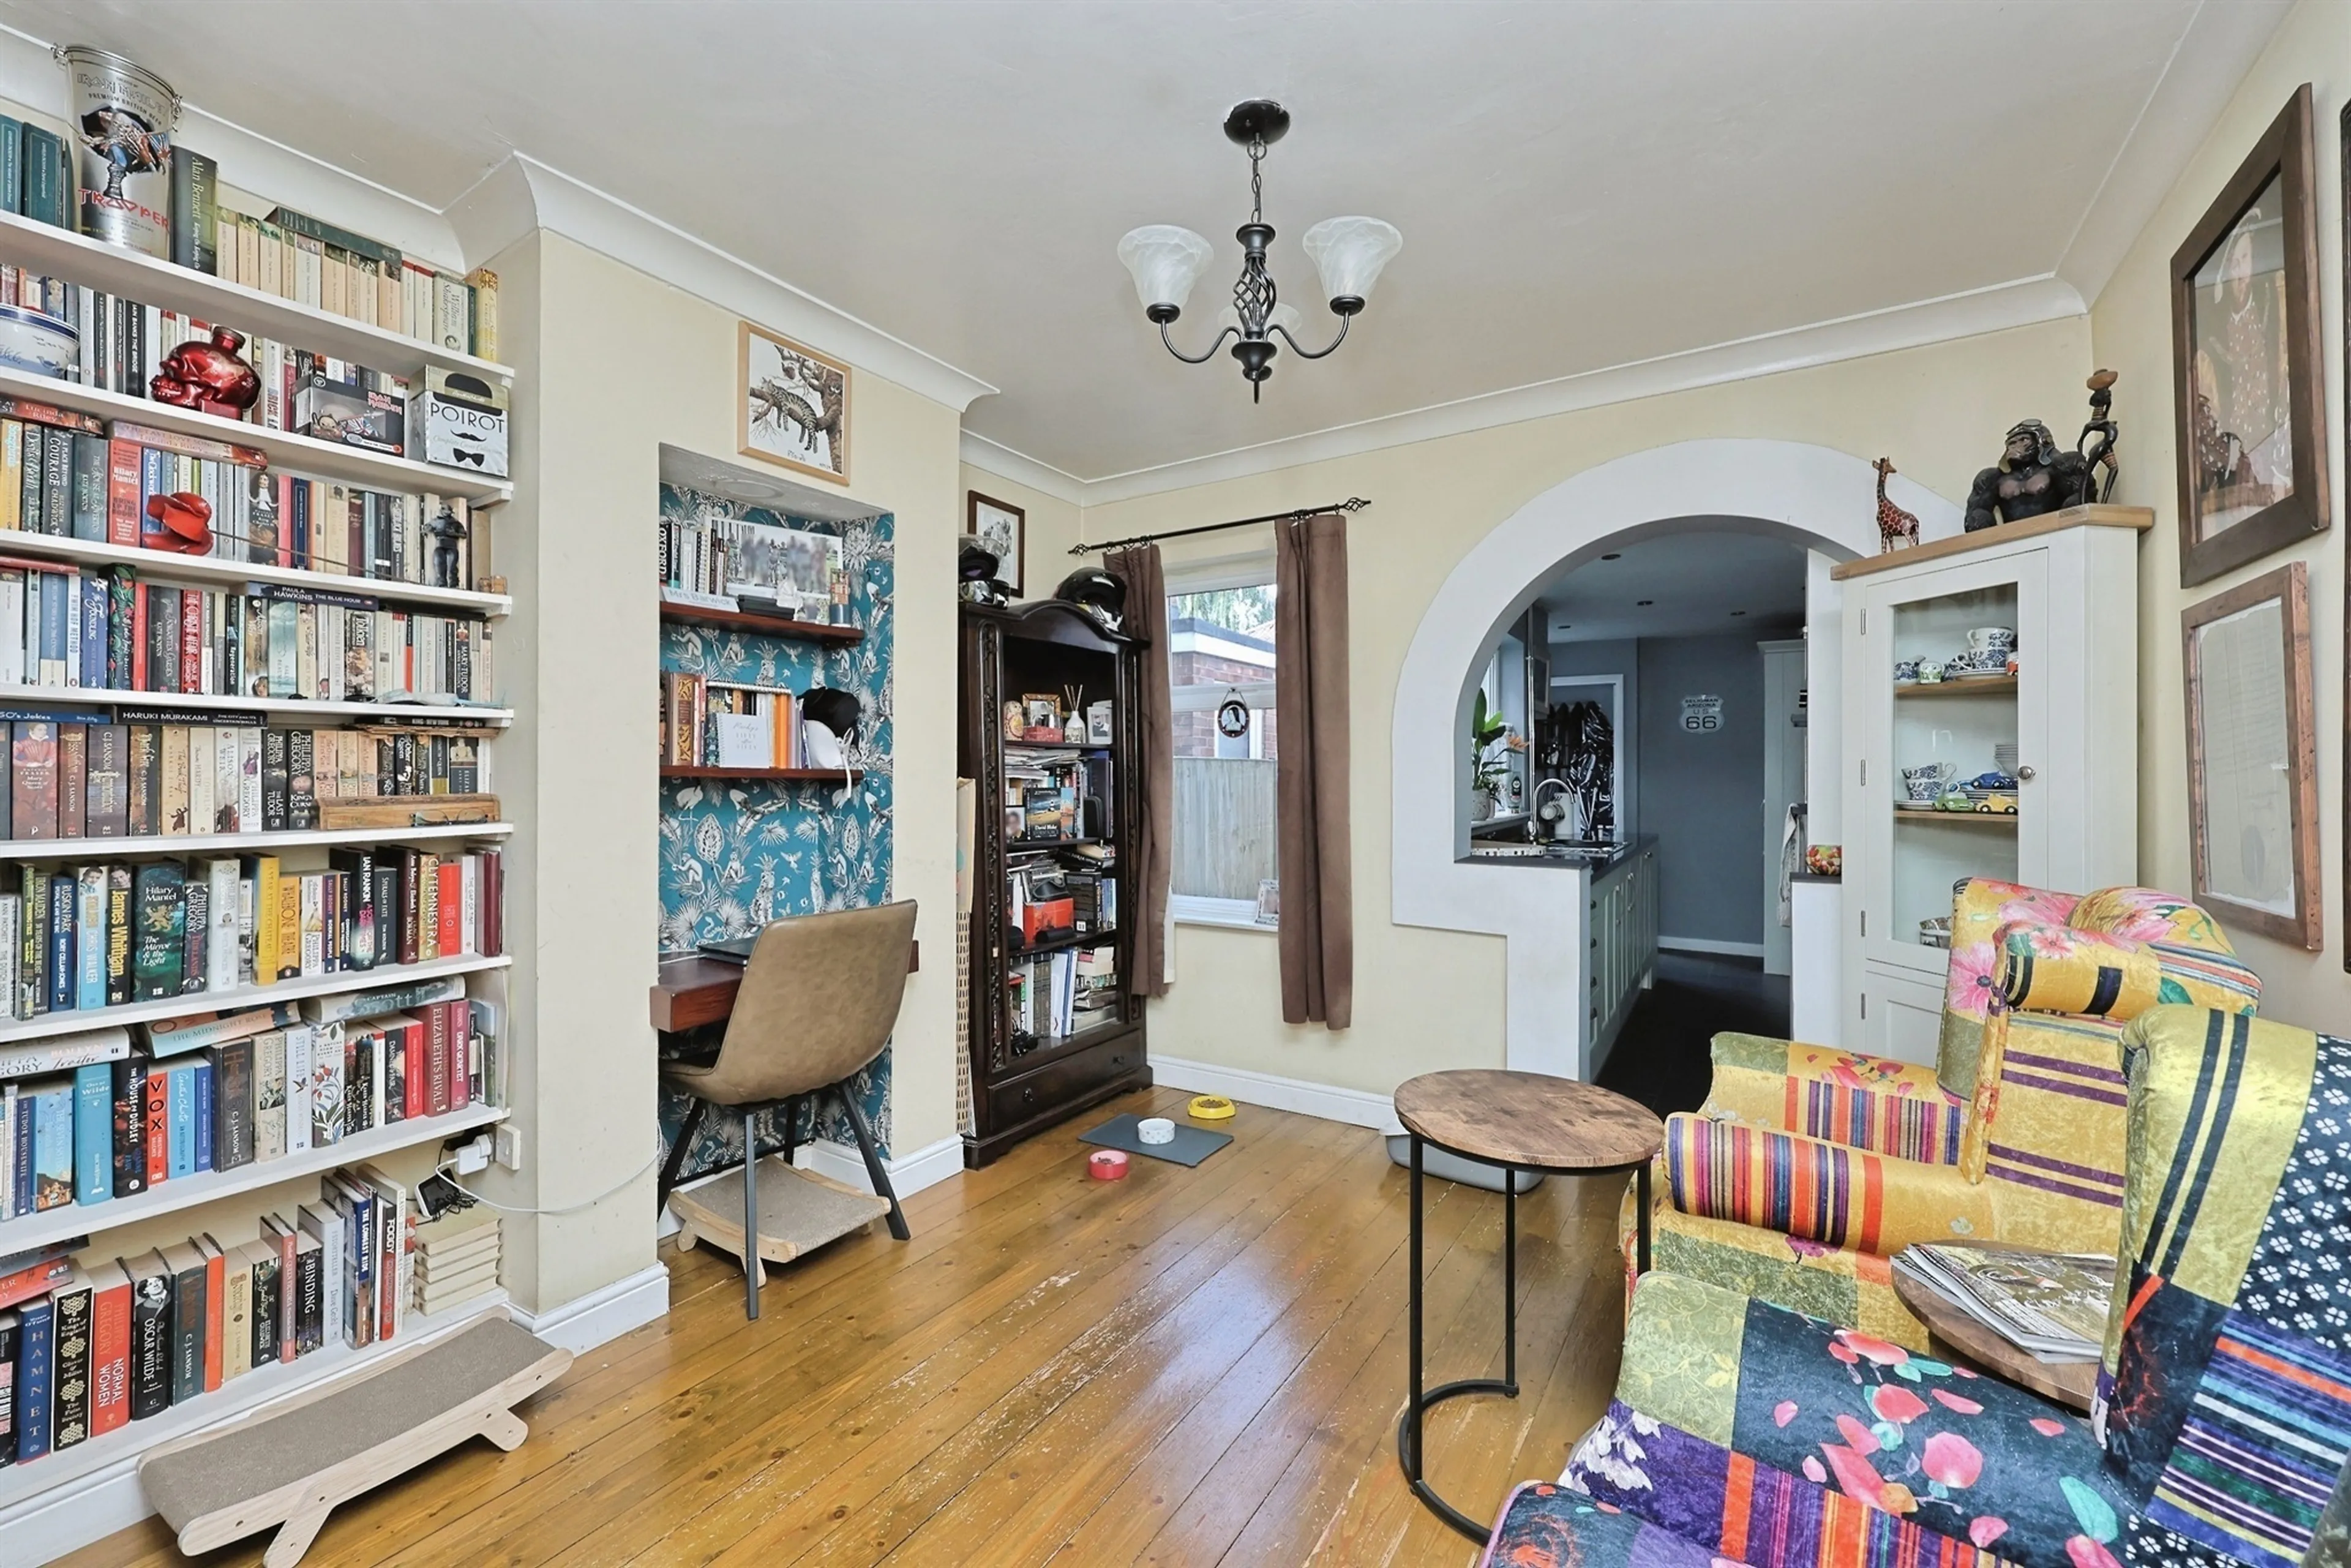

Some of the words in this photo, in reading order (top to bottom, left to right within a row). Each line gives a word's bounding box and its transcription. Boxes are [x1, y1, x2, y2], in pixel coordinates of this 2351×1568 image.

[192, 157, 204, 181] Alan
[78, 188, 171, 232] TROOPER
[192, 182, 204, 218] Bennett
[440, 282, 451, 333] Shakespeare
[451, 294, 460, 327] William
[25, 404, 64, 418] Lucinda
[32, 412, 57, 422] Riley
[268, 388, 279, 417] BRICK
[430, 402, 505, 434] POIROT
[48, 437, 61, 486] COURAGE
[91, 467, 103, 492] HOUSE
[50, 488, 58, 527] CHADWICK
[392, 508, 402, 533] SHERLOCK
[393, 533, 402, 553] HOLMES
[187, 594, 198, 606] THE
[274, 591, 314, 601] HAWKINS
[184, 606, 198, 634] CHRISTIE
[356, 617, 369, 647] Tolkien
[186, 634, 198, 655] AFFAIR
[160, 713, 208, 721] MURAKAMI
[1685, 715, 1717, 729] 66
[103, 742, 113, 770] SANSOM
[291, 731, 301, 776] GREGORY
[302, 735, 310, 773] PHILIPPA
[362, 856, 372, 871] IAN
[35, 877, 45, 893] IRON
[62, 885, 72, 913] RUSKIN
[145, 887, 173, 896] Hilary
[145, 893, 176, 902] Mantel
[362, 872, 372, 902] RANKIN
[35, 894, 45, 918] MAIDEN
[111, 890, 127, 925] James
[187, 892, 198, 932] GREGORY
[197, 894, 206, 930] PHILIPPA
[281, 885, 296, 928] WHALEBONE
[427, 858, 438, 947] CLYTEMNESTRA
[62, 914, 72, 932] PARK
[86, 930, 98, 951] CHRIS
[110, 925, 127, 976] Whitham
[281, 931, 295, 955] THEATRE
[86, 953, 98, 983] WALKER
[143, 958, 165, 966] Light
[190, 934, 201, 977] TIDELANDS
[194, 1021, 242, 1038] MIDNIGHT
[433, 1008, 442, 1073] ELIZABETH'S
[263, 1037, 272, 1077] GREGORY
[296, 1035, 304, 1058] STILL
[296, 1061, 304, 1078] LIFE
[81, 1085, 110, 1095] Wilde
[129, 1078, 138, 1105] HOUSE
[177, 1073, 189, 1097] Agatha
[433, 1075, 443, 1104] RIVAL
[149, 1079, 166, 1131] VOX
[178, 1098, 189, 1122] Christie
[129, 1113, 138, 1142] DUDLEY
[386, 1218, 396, 1254] FOGGY
[304, 1264, 315, 1313] BINDING
[99, 1302, 112, 1356] GREGORY
[114, 1304, 125, 1346] PHILIPPA
[144, 1318, 156, 1349] OSCAR
[111, 1357, 124, 1405] NORMAL
[143, 1351, 155, 1382] WILDE
[98, 1364, 111, 1408] WOMEN
